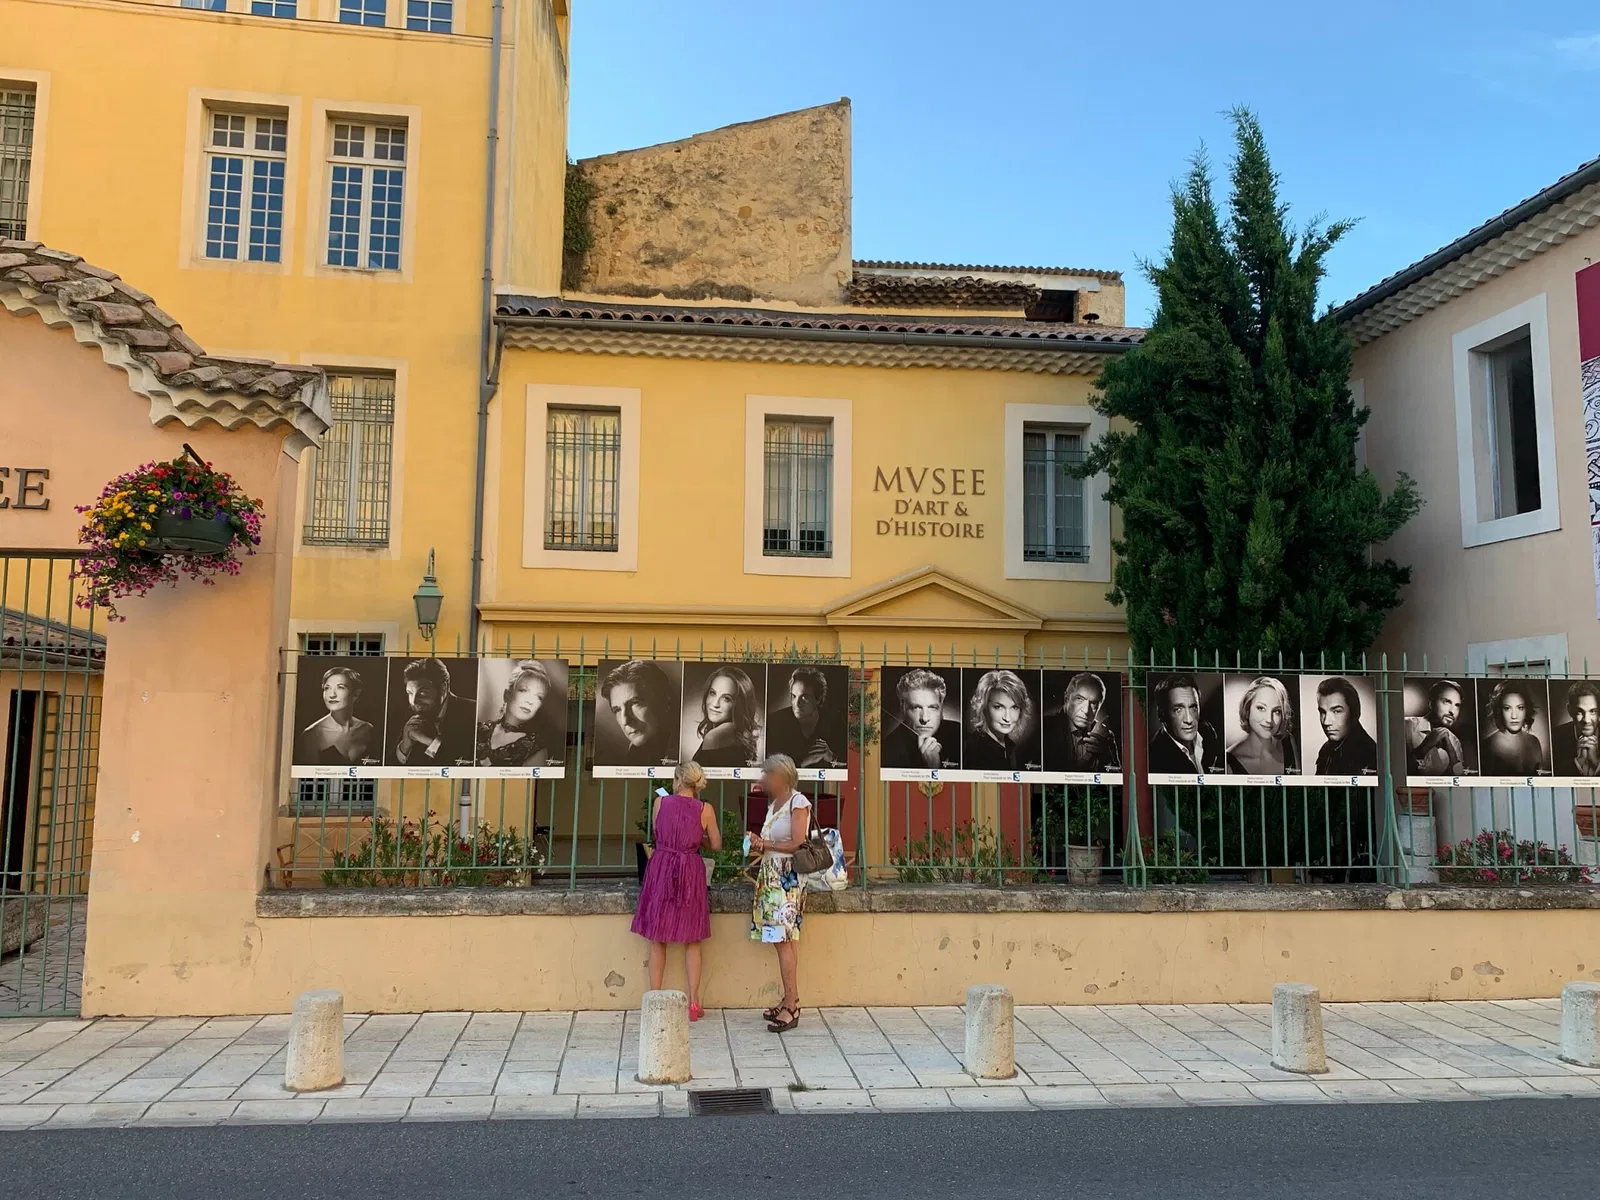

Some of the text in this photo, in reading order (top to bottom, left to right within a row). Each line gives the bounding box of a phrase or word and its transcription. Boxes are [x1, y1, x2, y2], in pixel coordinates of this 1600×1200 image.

[0, 467, 50, 510] E
[873, 465, 985, 495] MVSEE
[895, 498, 969, 516] D'ART &
[876, 517, 984, 538] D'HISTOIRE
